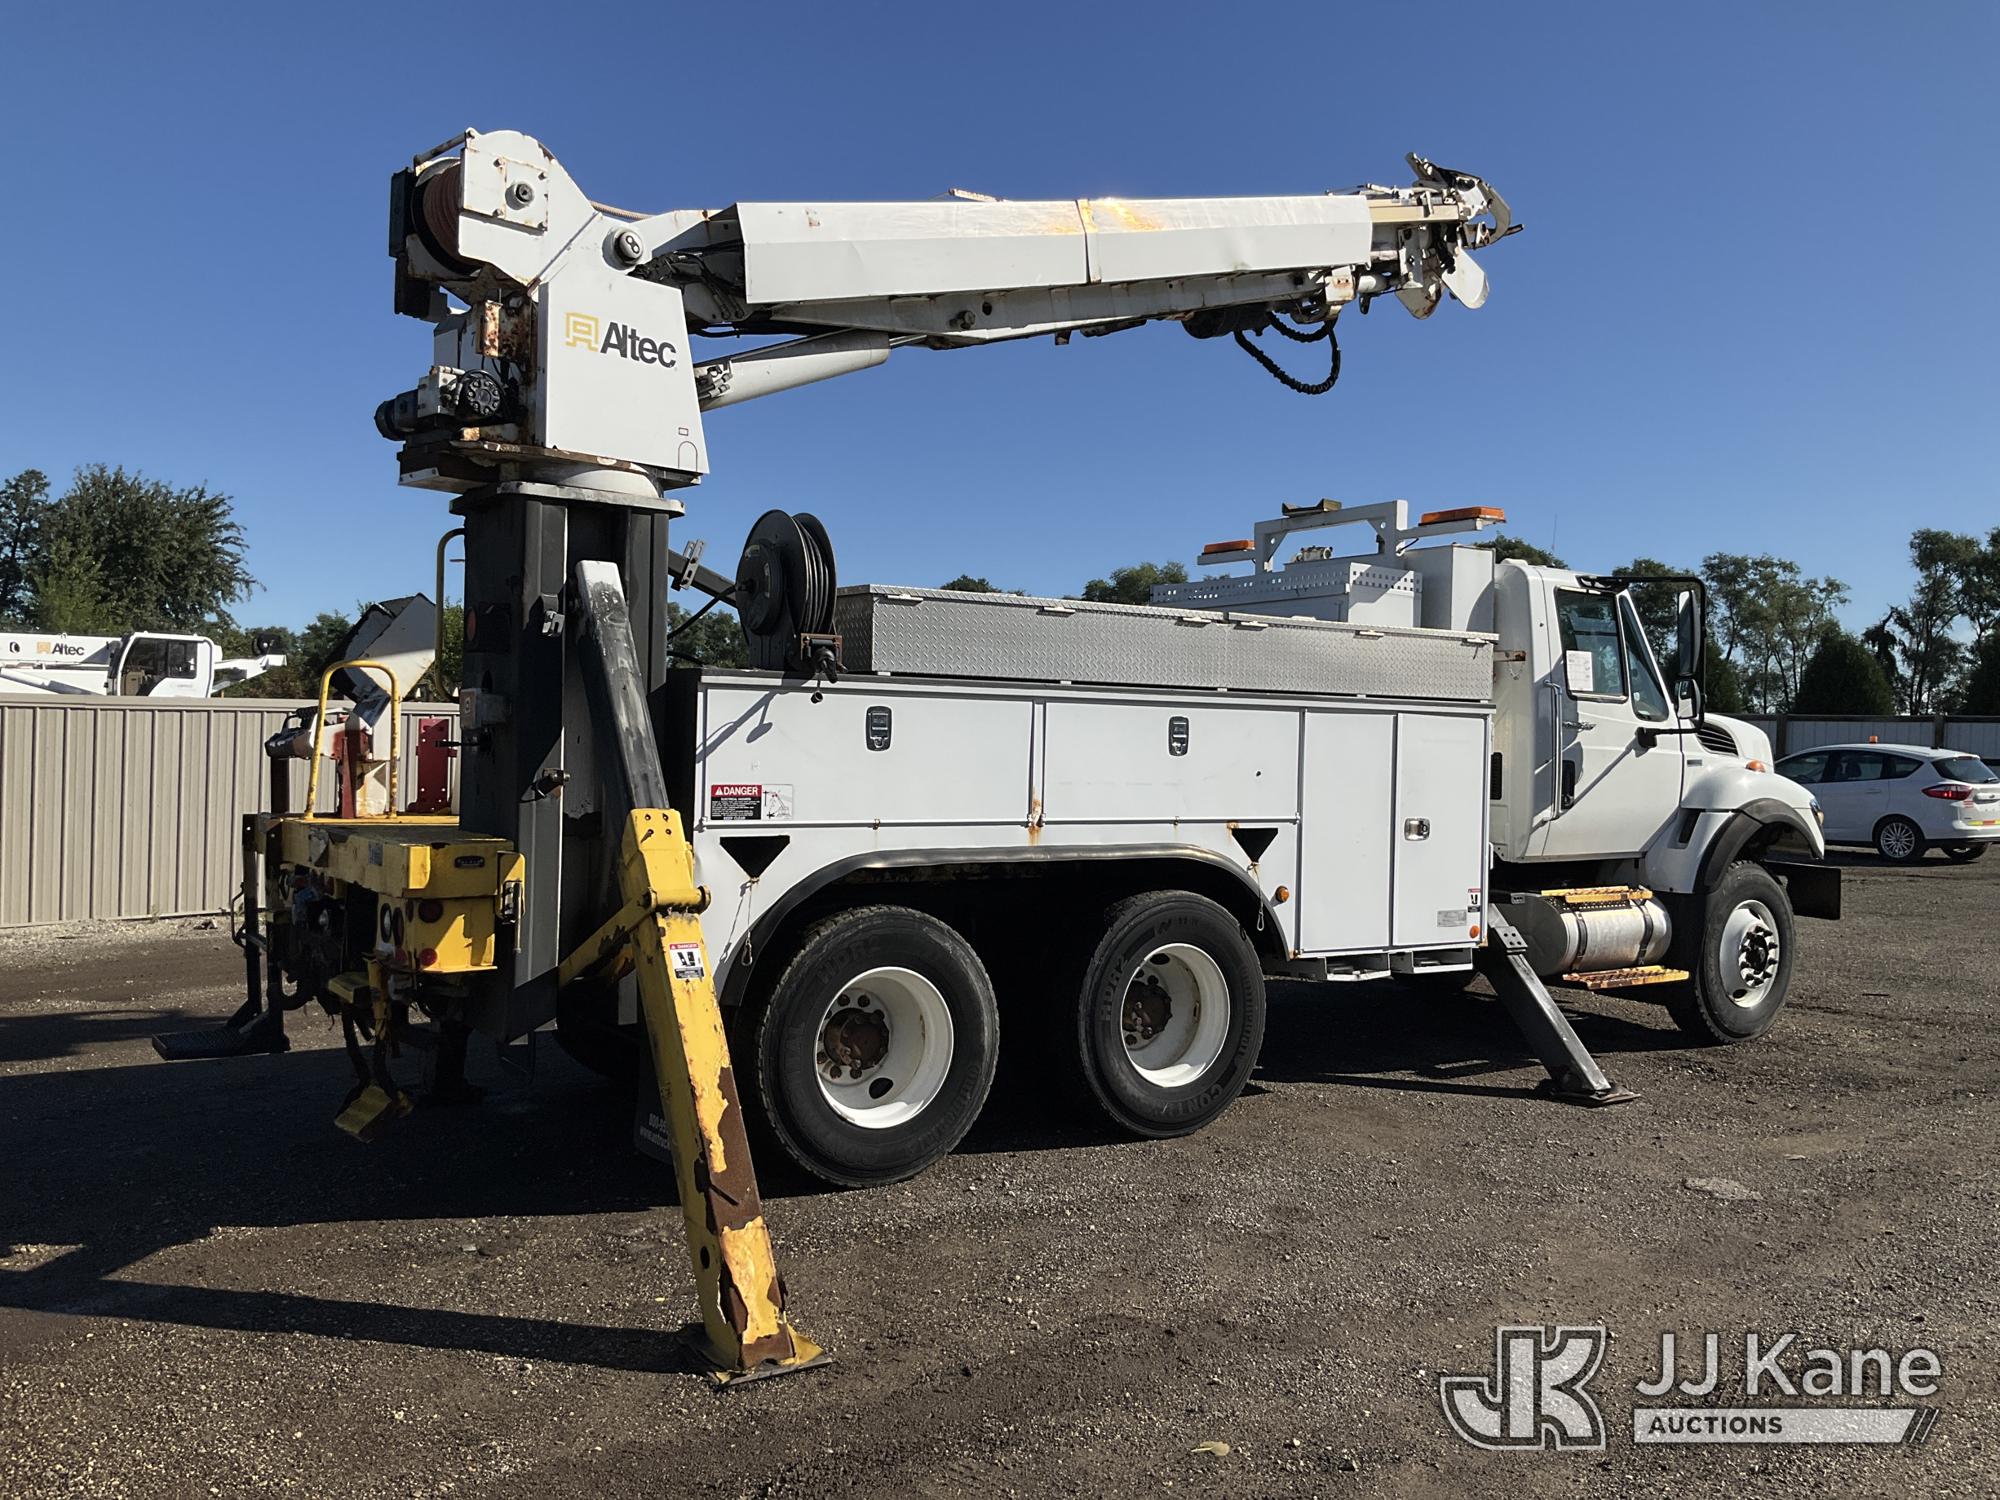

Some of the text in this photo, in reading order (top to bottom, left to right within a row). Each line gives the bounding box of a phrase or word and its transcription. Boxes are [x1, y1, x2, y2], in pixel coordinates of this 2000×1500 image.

[600, 321, 677, 369] Altec
[52, 642, 85, 656] Altec
[723, 786, 758, 796] DANGER
